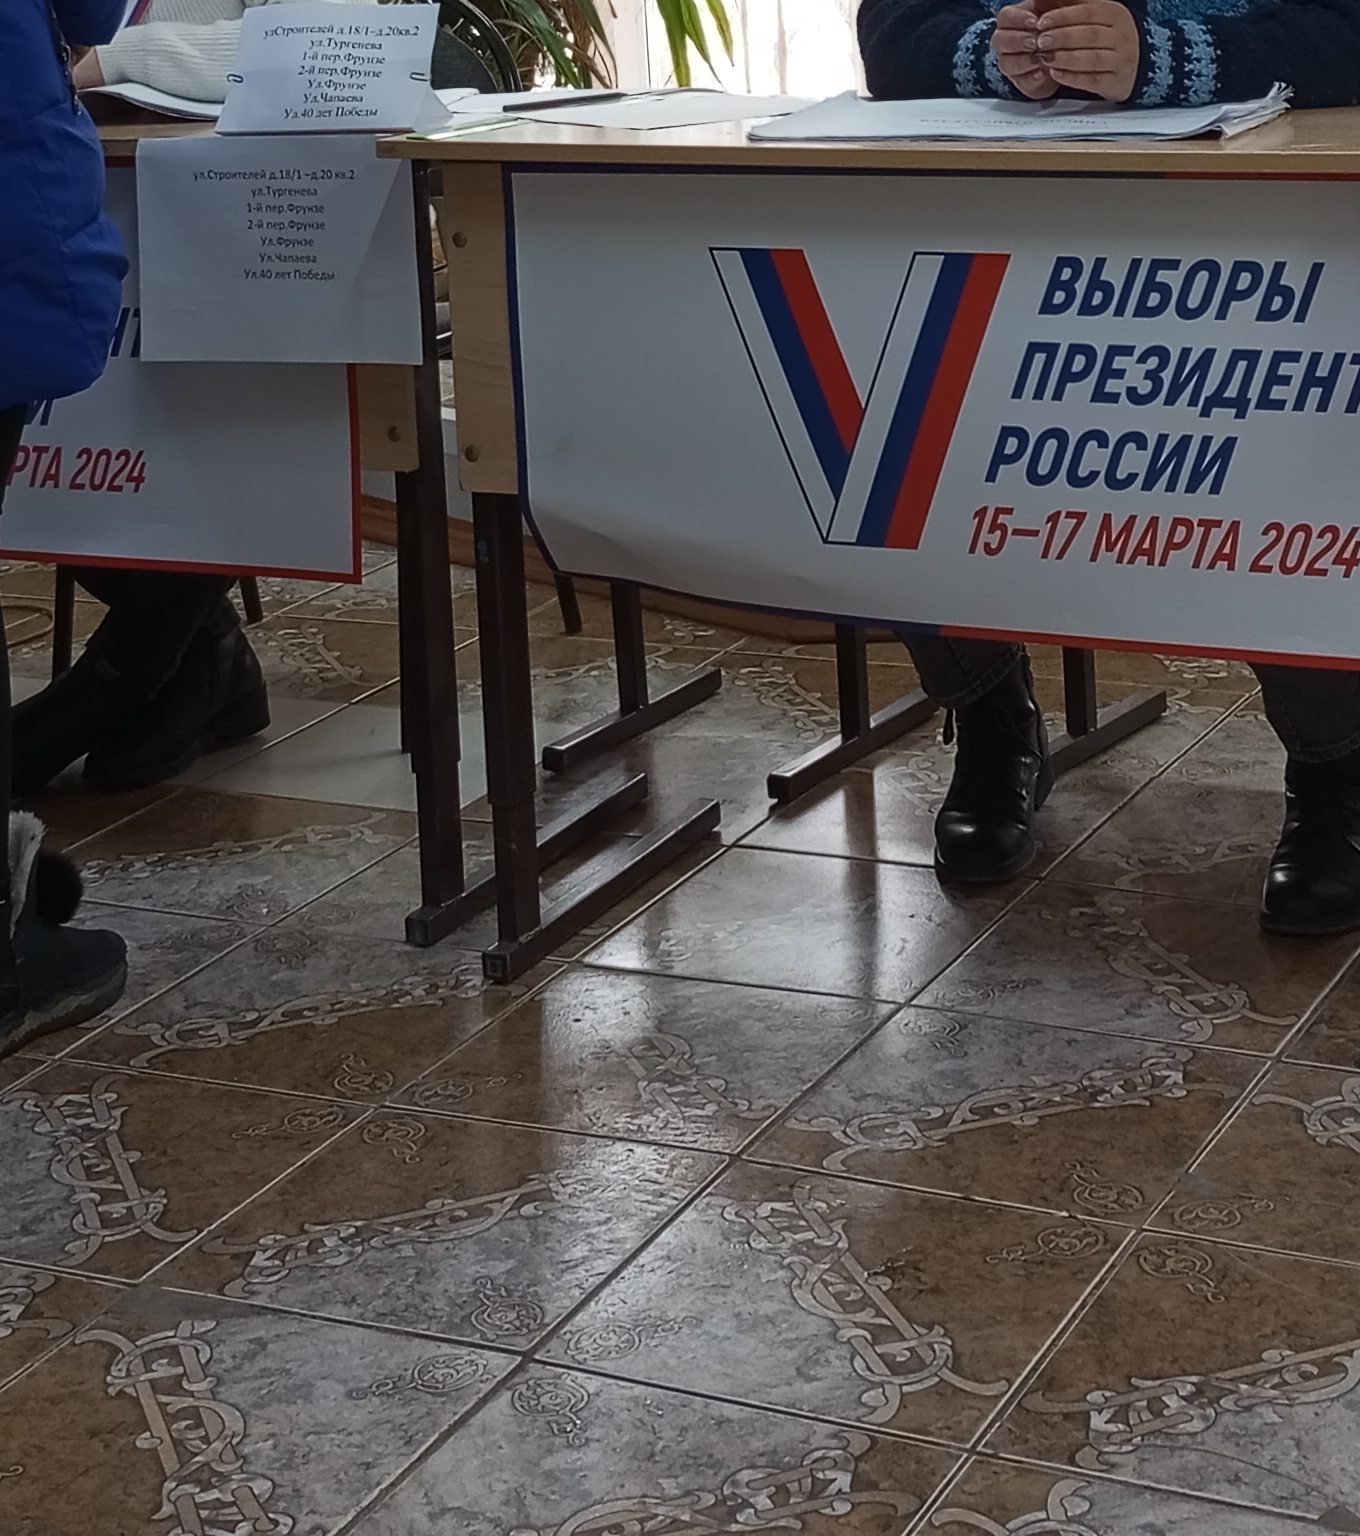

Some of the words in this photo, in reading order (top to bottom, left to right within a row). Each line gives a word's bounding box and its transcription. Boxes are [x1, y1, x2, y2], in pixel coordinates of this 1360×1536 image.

[335, 107, 378, 118] Победы
[193, 169, 267, 181] ул.Строителей
[268, 169, 302, 181] д.18/1
[251, 186, 318, 198] ул.Тургенева
[247, 202, 263, 213] 1-й
[265, 203, 325, 215] пер.Фрунзе
[247, 219, 264, 230] 2-й
[266, 220, 326, 232] пер.Фрунзе
[260, 236, 315, 248] Ул.Фрунзе
[259, 253, 317, 264] Ул.Чапаева
[244, 269, 272, 280] Ул.40
[274, 271, 291, 279] лет
[294, 269, 335, 281] Победы
[1038, 255, 1325, 323] ВЫБОРЫ
[985, 425, 1238, 495] РОССИИ
[69, 447, 147, 493] 2024
[1089, 512, 1241, 572] МАРТА
